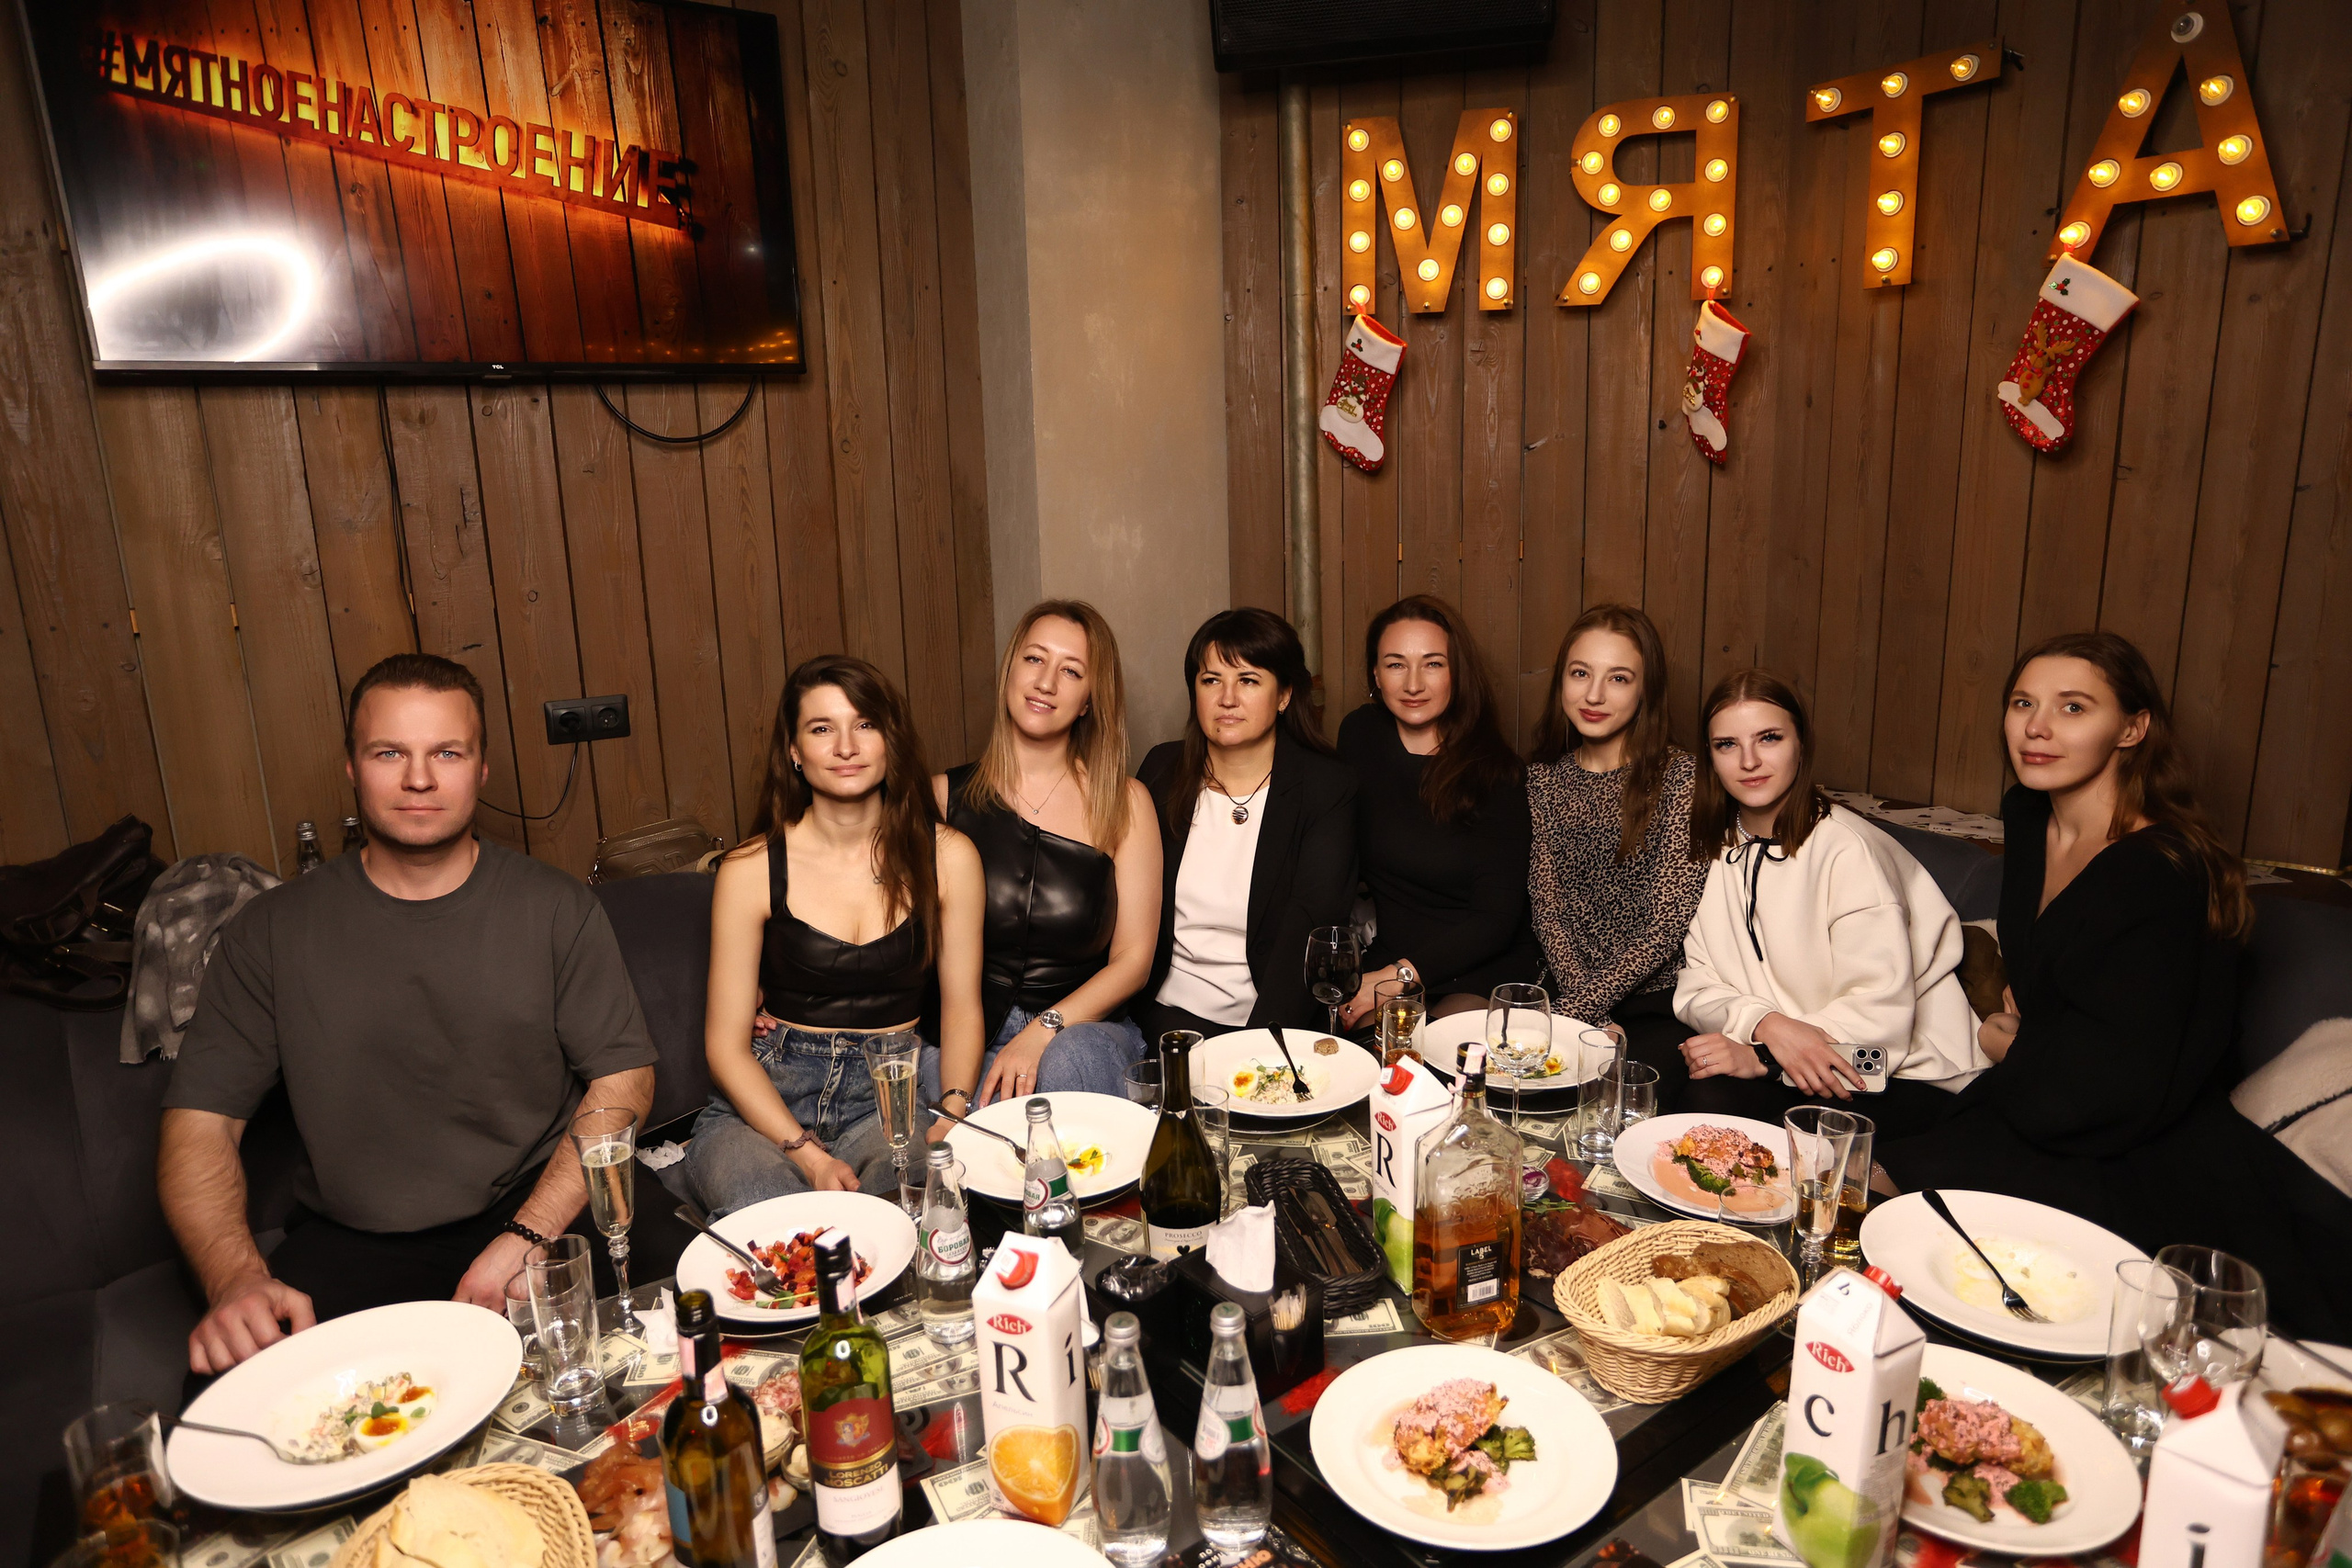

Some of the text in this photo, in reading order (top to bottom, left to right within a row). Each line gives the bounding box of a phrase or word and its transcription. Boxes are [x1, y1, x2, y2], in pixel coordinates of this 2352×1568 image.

[95, 28, 680, 208] #МЯТНОЕНАСТРОЕНИЕ
[1377, 1111, 1394, 1131] Rich
[1375, 1131, 1396, 1189] R
[1470, 1245, 1492, 1256] LABEL
[992, 1314, 1027, 1334] Rich
[1810, 1340, 1849, 1373] Rich
[824, 1463, 888, 1487] MOSCATTI
[829, 1461, 882, 1479] LORENZO
